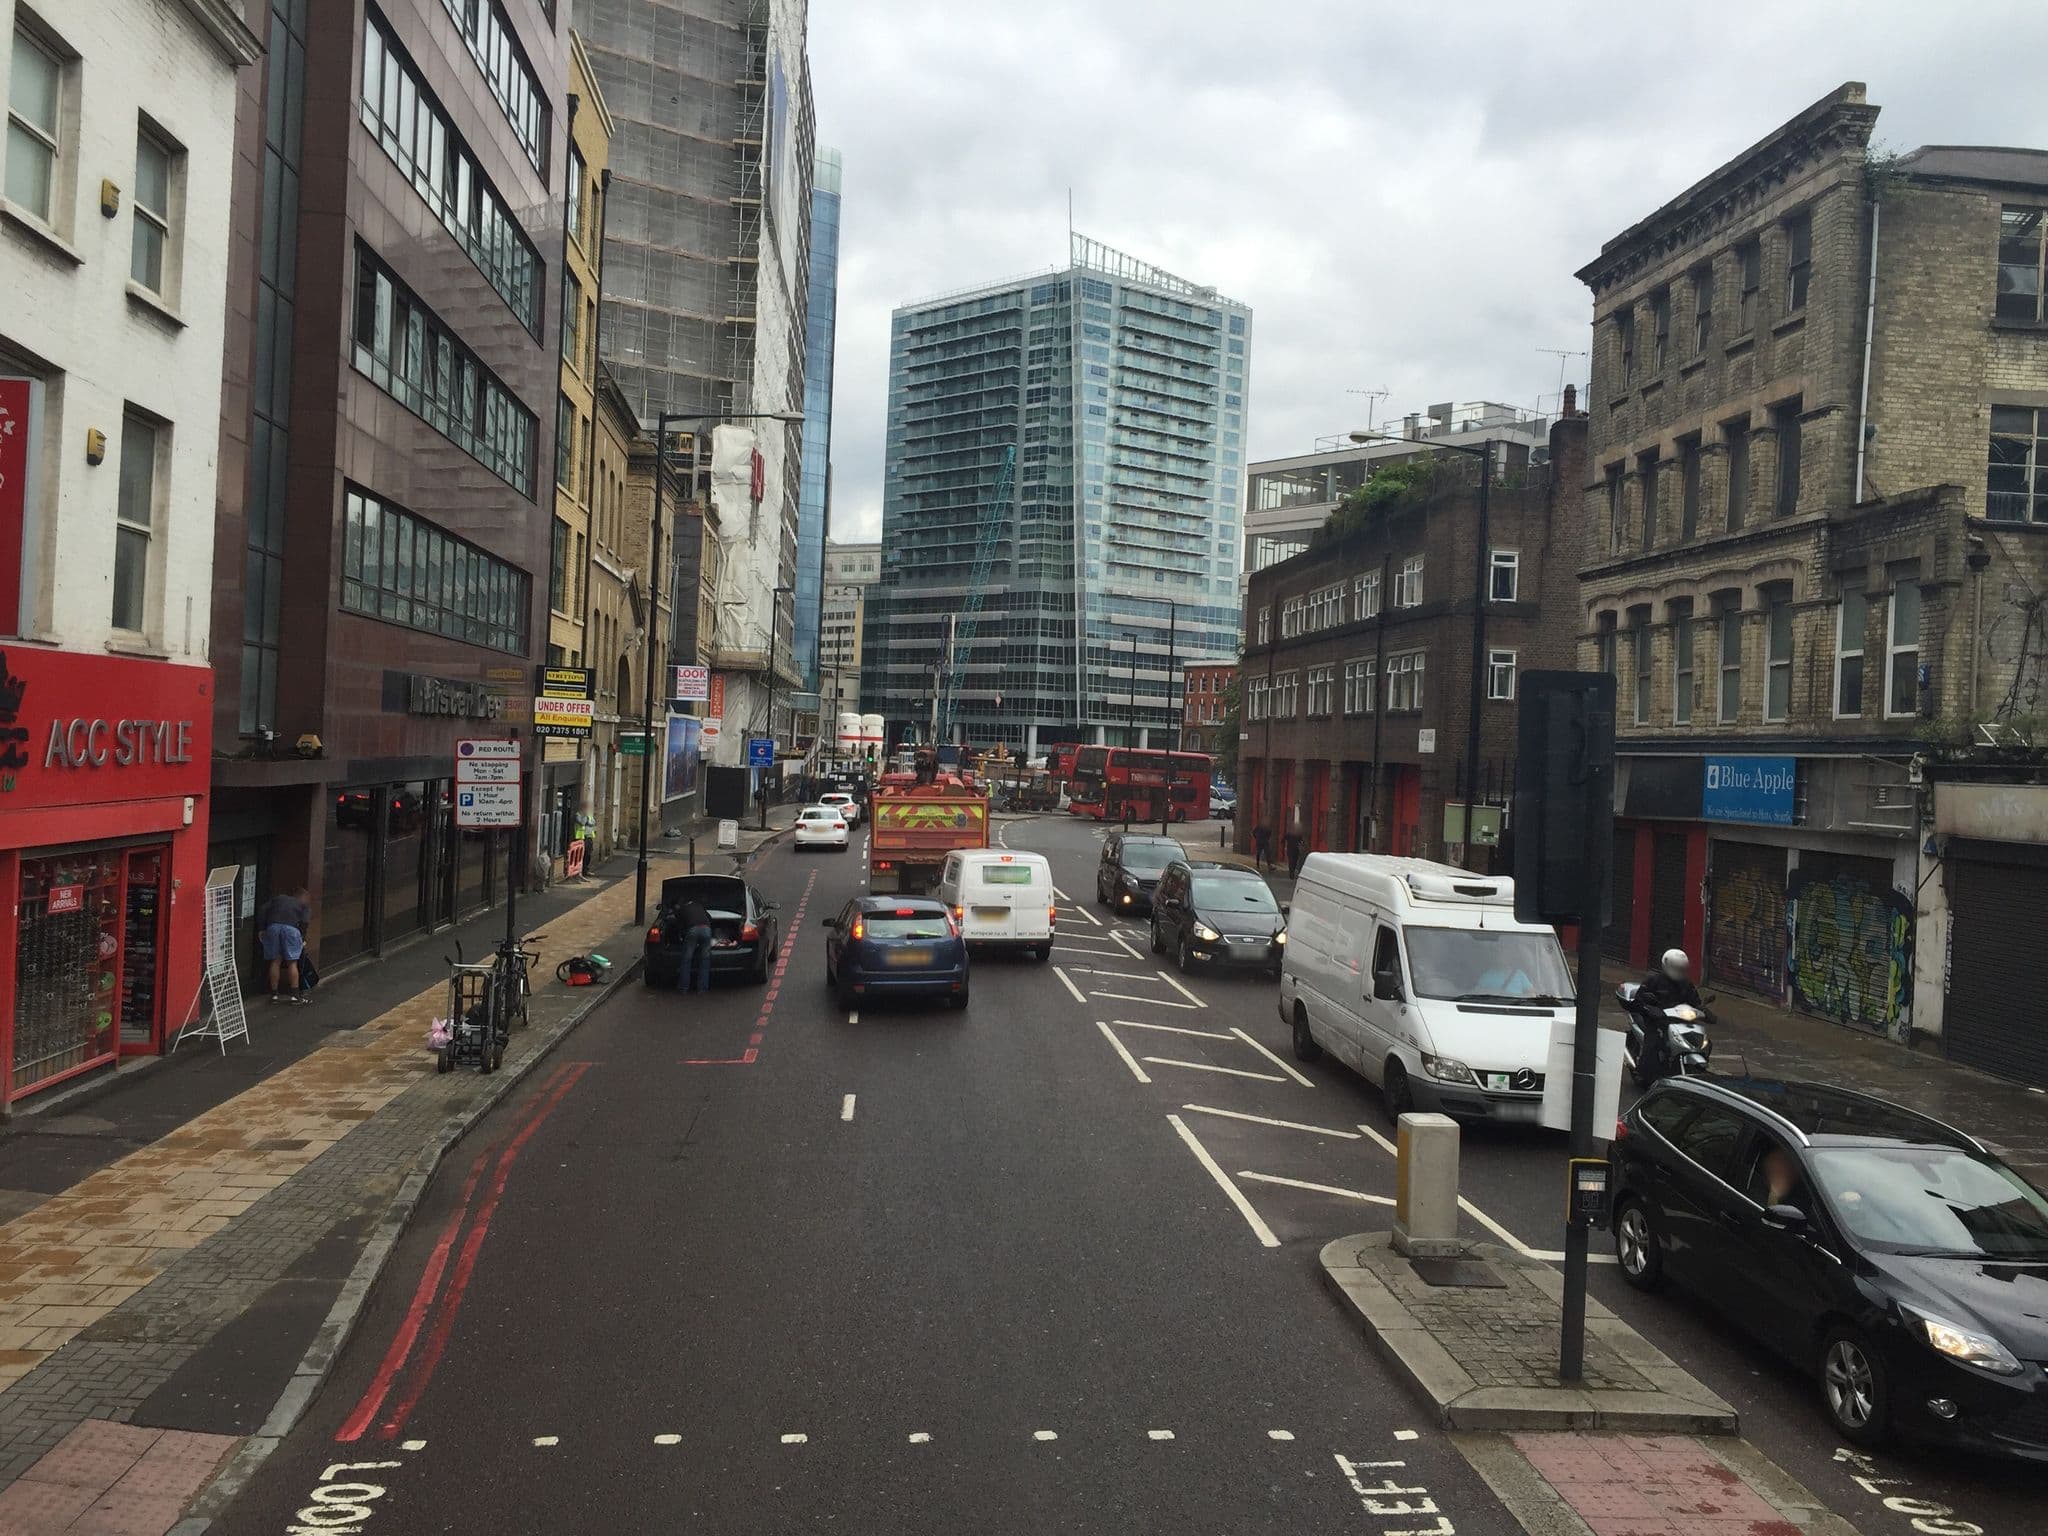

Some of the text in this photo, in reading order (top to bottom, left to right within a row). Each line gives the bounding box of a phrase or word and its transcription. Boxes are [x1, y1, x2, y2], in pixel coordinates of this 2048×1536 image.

[679, 669, 706, 678] LOOK
[538, 701, 564, 712] UNDER
[566, 702, 590, 713] OFFER
[45, 718, 192, 768] ACC STYLE
[1721, 766, 1794, 794] Blue Apple
[60, 889, 72, 899] NEW
[52, 897, 77, 910] ARRIVALS
